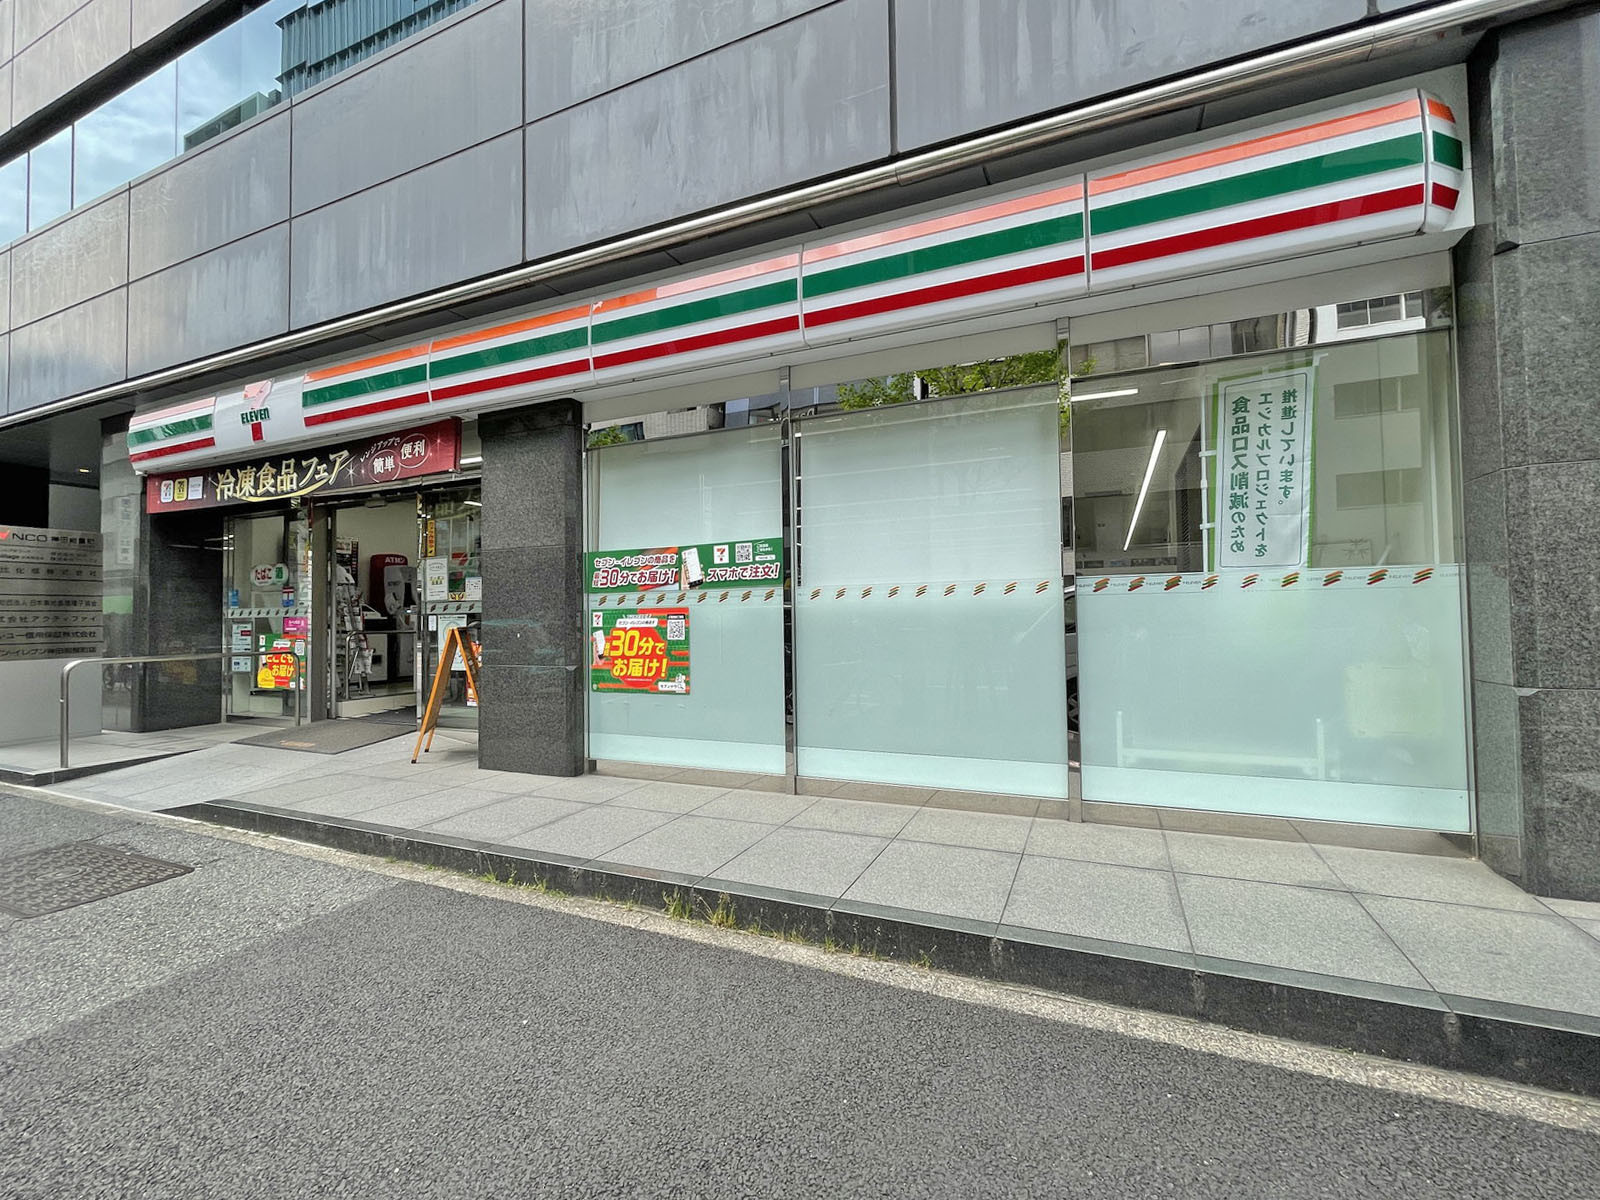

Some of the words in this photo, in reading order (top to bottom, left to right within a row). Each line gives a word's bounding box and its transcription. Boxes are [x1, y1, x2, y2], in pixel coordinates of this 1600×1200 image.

[401, 440, 425, 459] 便利
[373, 456, 395, 474] 簡単
[216, 450, 350, 502] 冷凍食品フェア
[12, 533, 47, 542] NCO
[708, 564, 780, 581] スマホで注文!
[612, 658, 668, 677] お届け!
